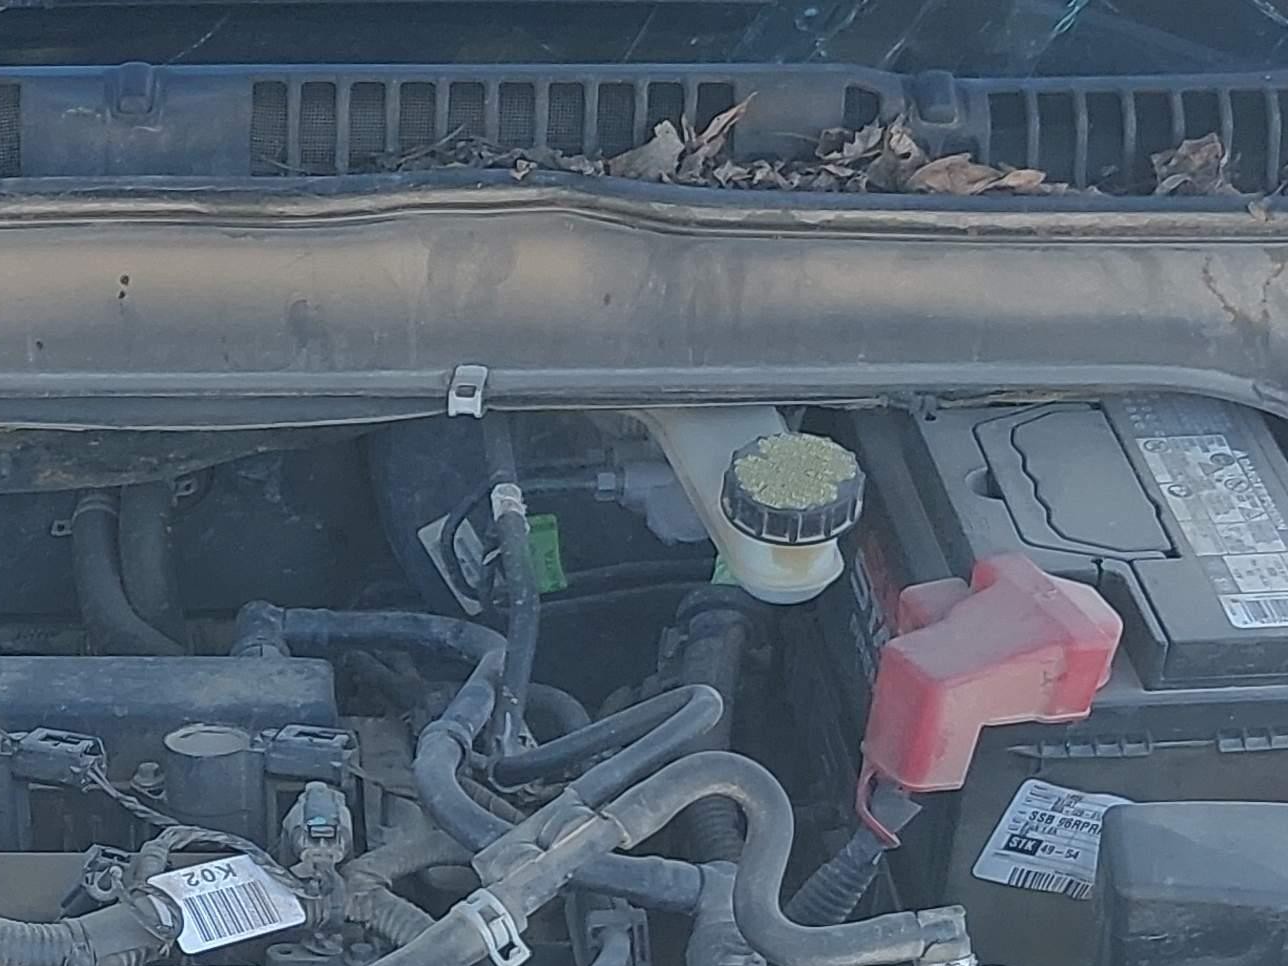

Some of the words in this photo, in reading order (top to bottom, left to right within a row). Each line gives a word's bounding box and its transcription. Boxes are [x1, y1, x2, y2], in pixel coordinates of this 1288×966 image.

[1028, 811, 1055, 825] SSB
[1008, 837, 1036, 852] STK
[182, 863, 238, 888] K02
